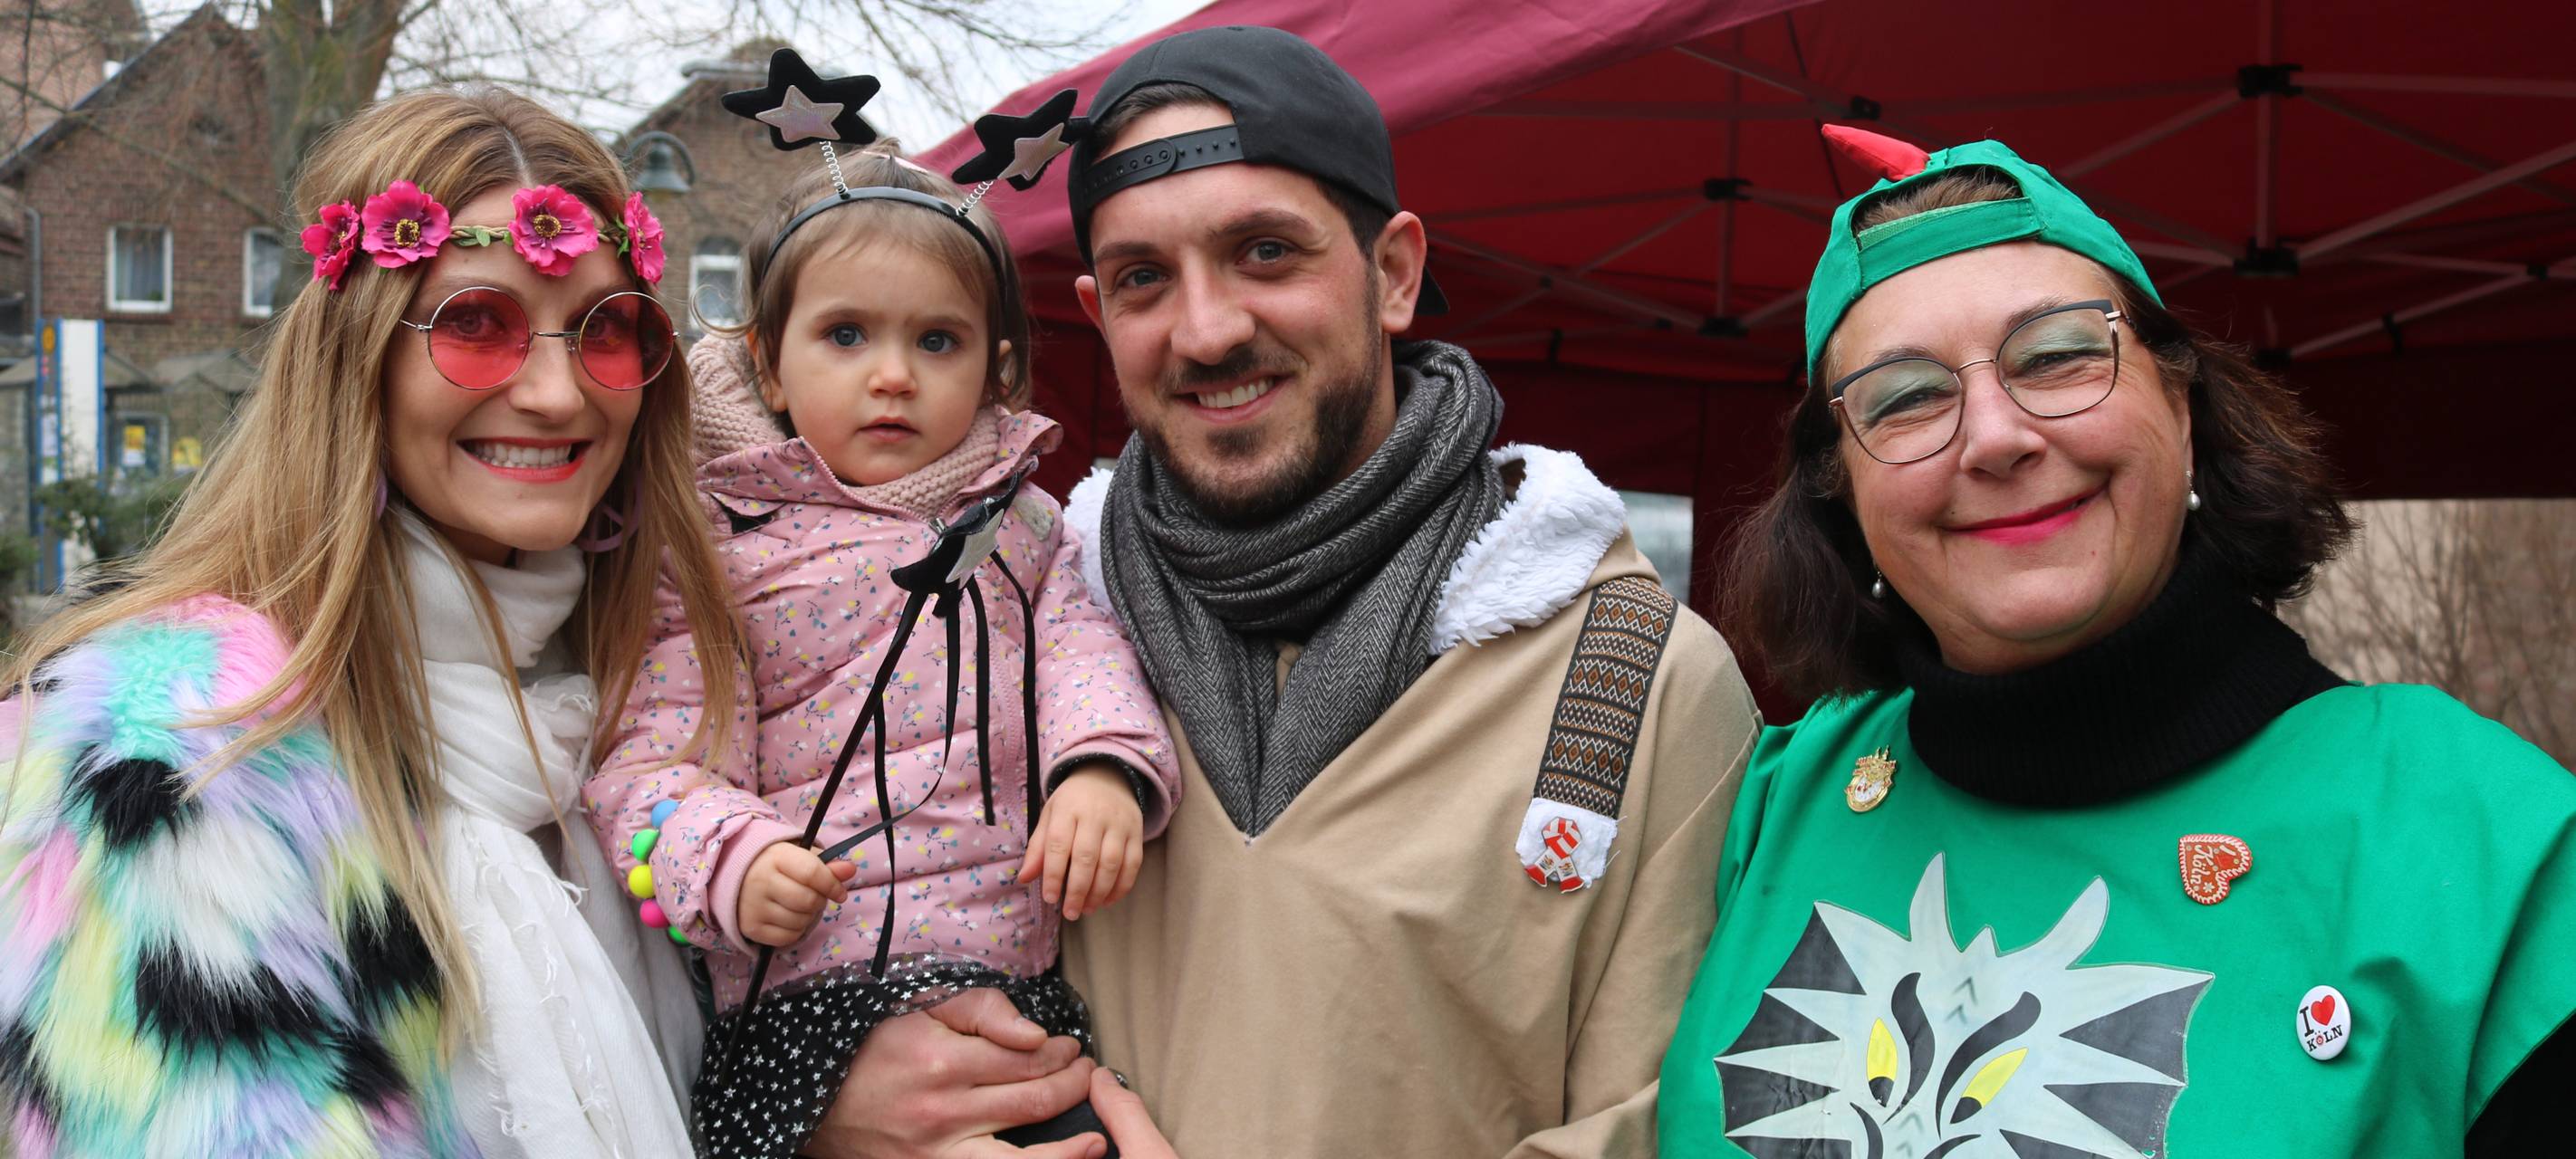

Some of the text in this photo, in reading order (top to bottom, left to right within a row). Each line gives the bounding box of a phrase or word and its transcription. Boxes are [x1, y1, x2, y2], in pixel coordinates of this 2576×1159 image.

[2190, 844, 2214, 885] Köln
[2300, 1005, 2314, 1038] I
[2306, 1024, 2343, 1052] KÖLN
